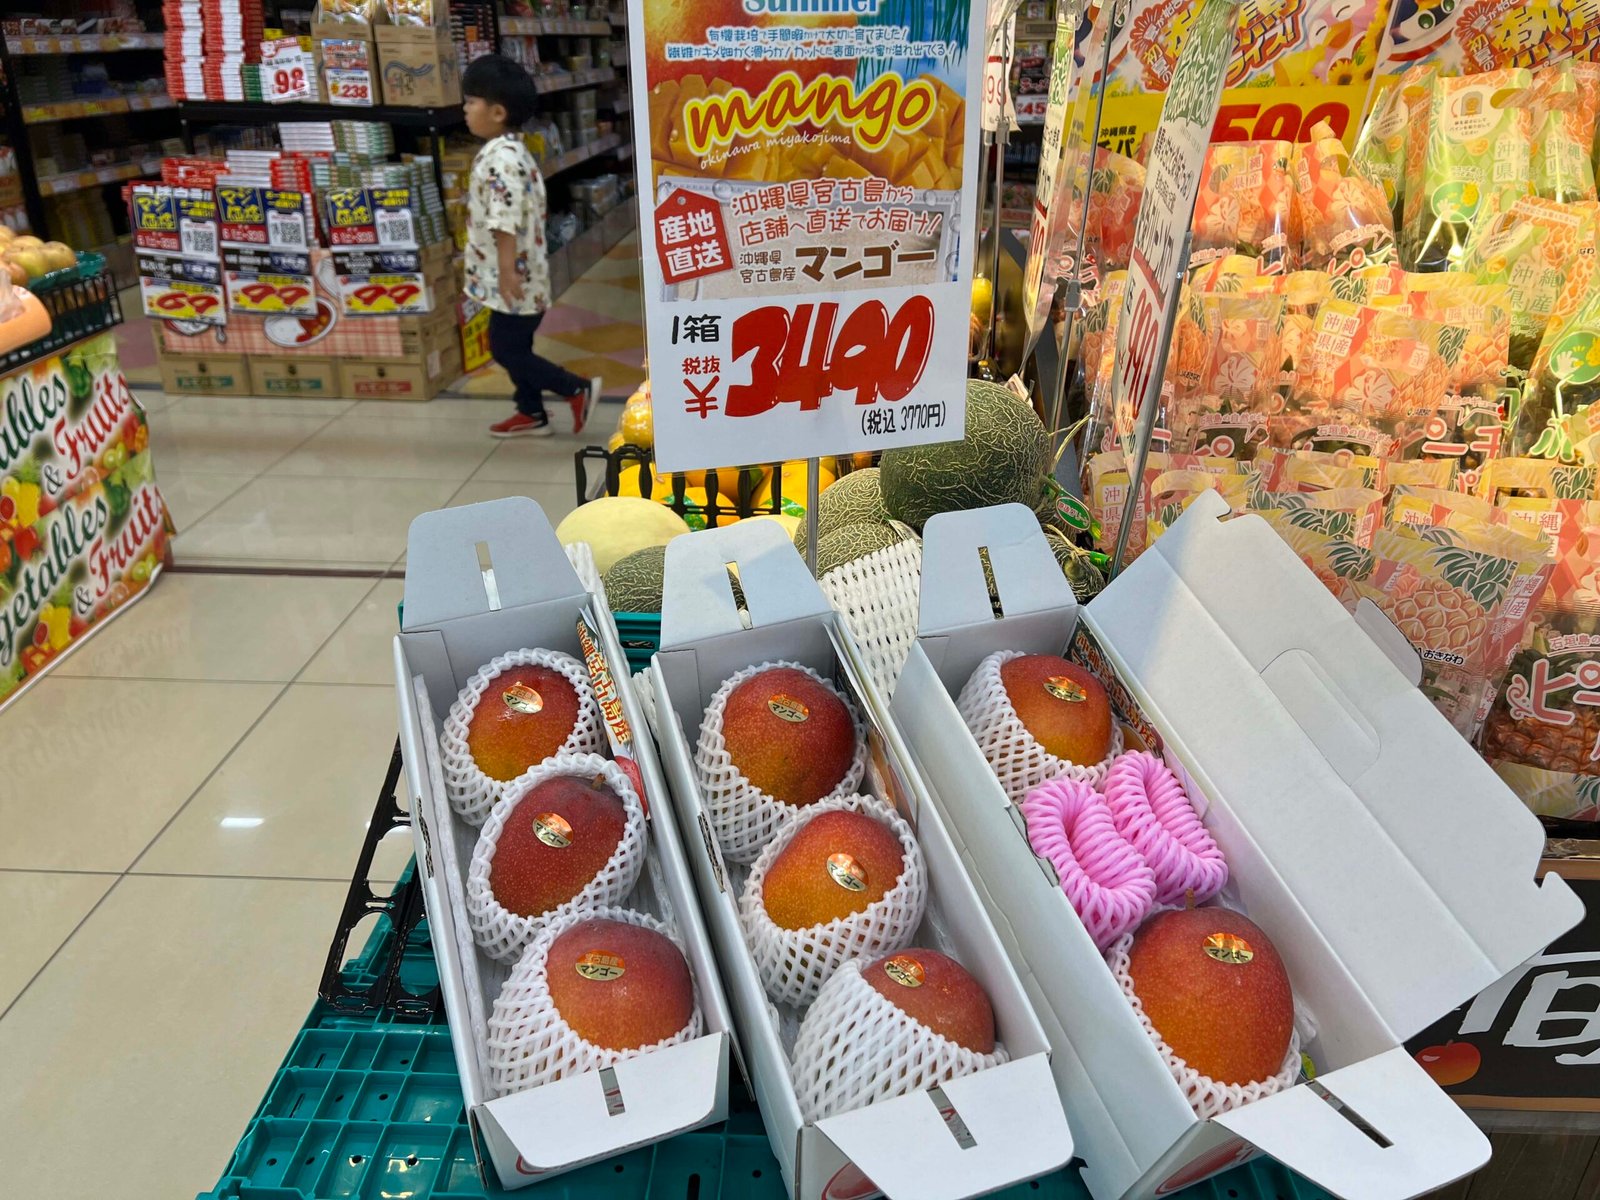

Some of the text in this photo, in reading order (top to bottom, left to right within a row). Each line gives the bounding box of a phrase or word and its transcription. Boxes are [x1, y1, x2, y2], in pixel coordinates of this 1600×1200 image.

[342, 83, 369, 99] 238
[688, 73, 933, 151] mango
[1100, 125, 1137, 138] 沖縄県産
[701, 130, 852, 170] okinawa miyakojima
[731, 179, 914, 217] 沖縄県宮古島から
[659, 209, 717, 241] 産地
[739, 208, 943, 247] 店舗へ直送でお届け!
[666, 239, 724, 277] 直送
[739, 250, 782, 266] 沖縄県
[795, 240, 936, 282] マンゴー
[740, 266, 796, 284] 宮古島産
[672, 314, 722, 344] 1箱
[681, 355, 721, 376] 税抜
[682, 294, 936, 419] ¥ 3490
[53, 372, 129, 479] Fruits
[861, 400, 947, 436] (税込 3770円)
[1423, 649, 1464, 667] おきなわ
[772, 703, 802, 721] マンゴー
[580, 964, 619, 977] マンゴー
